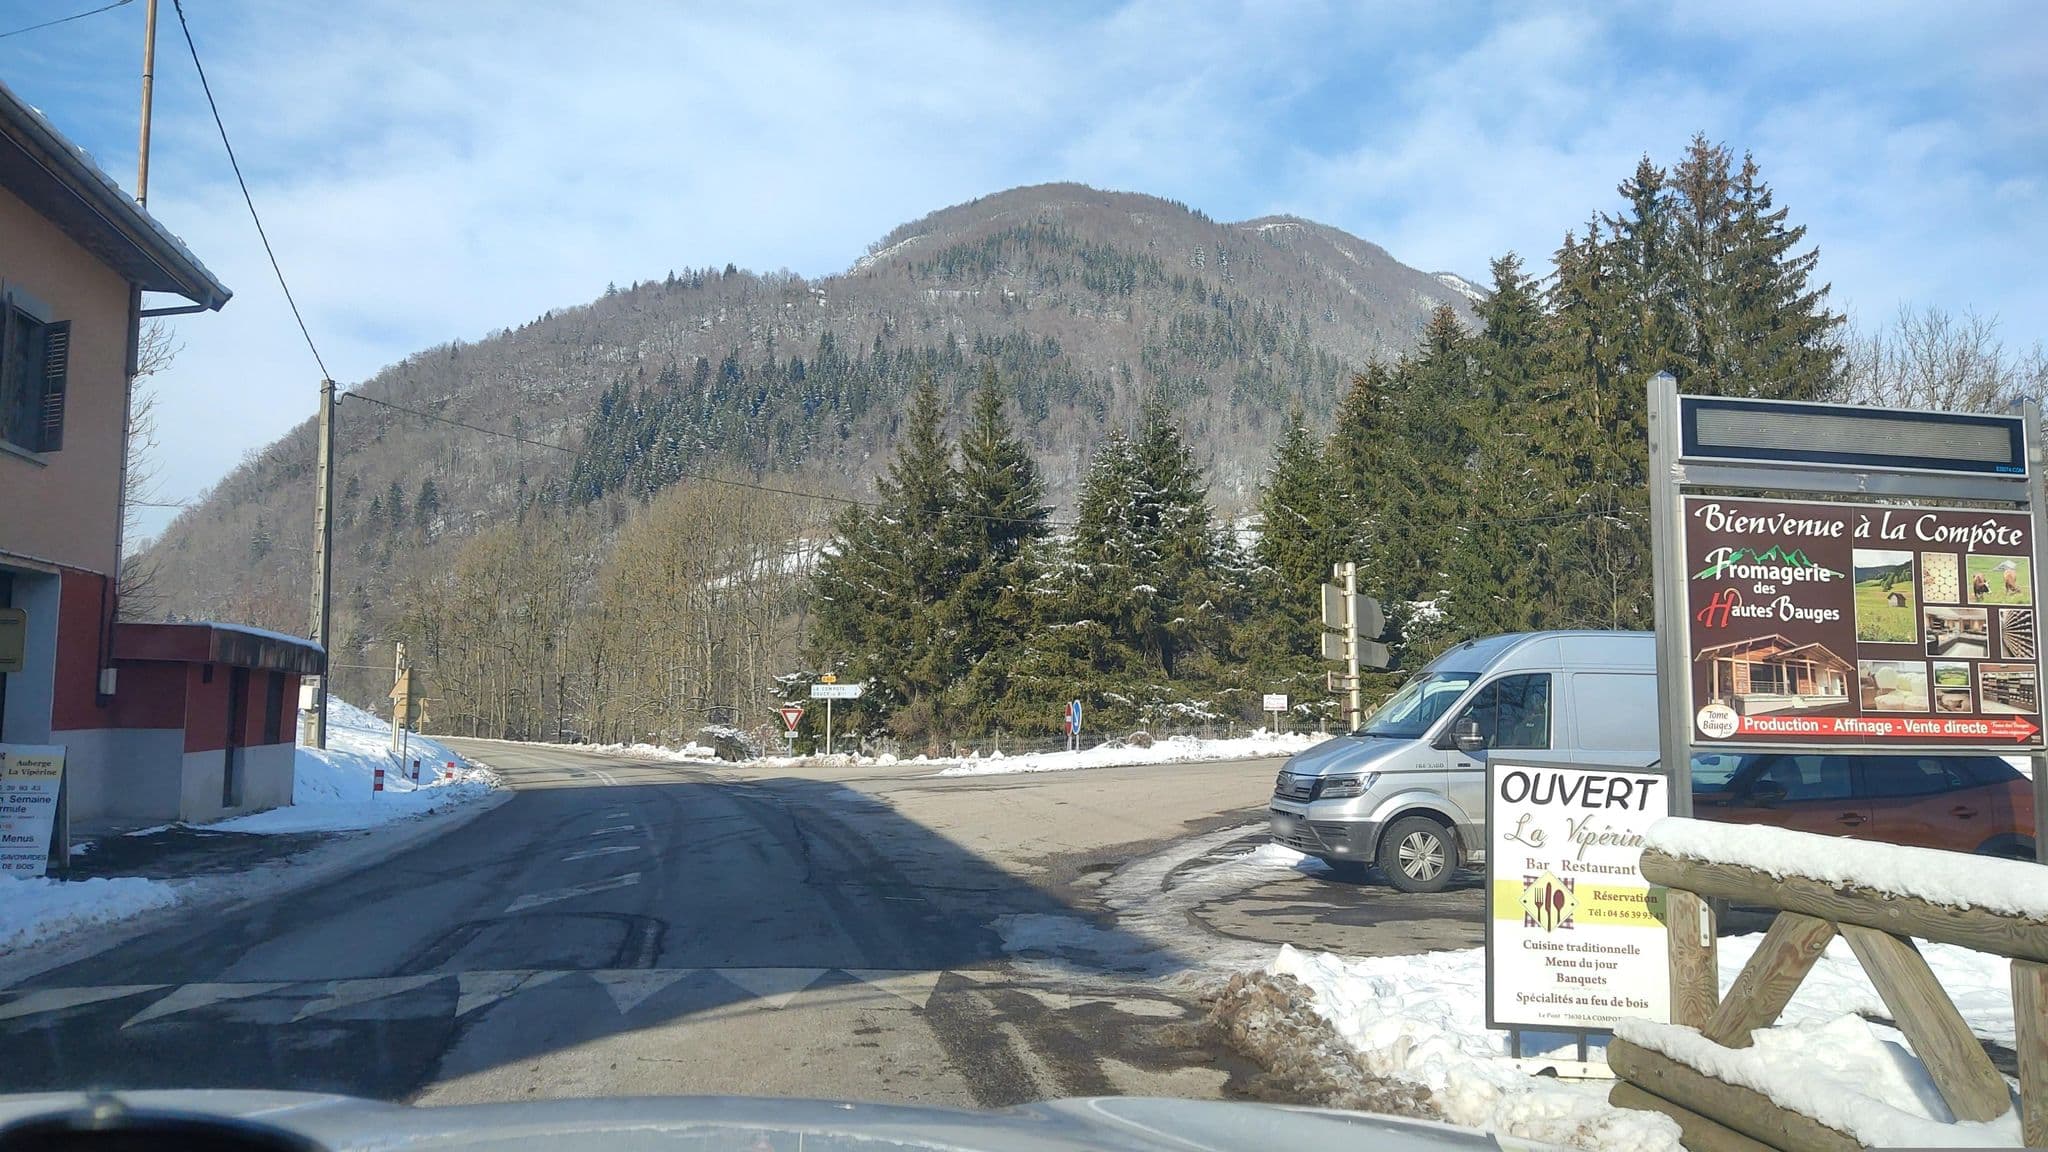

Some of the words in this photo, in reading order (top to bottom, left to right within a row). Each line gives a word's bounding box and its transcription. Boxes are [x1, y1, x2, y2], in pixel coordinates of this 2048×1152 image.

[1694, 503, 1845, 538] Bienvenue
[1854, 515, 1872, 538] à
[1880, 511, 1907, 540] la
[1915, 514, 2024, 552] Compôte
[1704, 547, 1831, 585] Fromagerie
[1753, 581, 1776, 594] des
[1697, 588, 1773, 628] Hautes
[1771, 595, 1840, 624] Bauges
[1706, 711, 1729, 719] Tome
[1703, 720, 1732, 736] Bauges
[1744, 717, 1819, 732] Production
[1834, 718, 1892, 735] Affinage
[1944, 721, 1988, 734] directe
[17, 760, 52, 768] Auberge
[10, 795, 52, 803] Semaine
[1500, 771, 1659, 811] OUVERT
[1504, 812, 1548, 848] La
[1566, 814, 1646, 861] Vipérin
[1526, 857, 1550, 870] Bar
[1561, 859, 1636, 875] Restaurant
[1593, 890, 1658, 903] Réservation
[1607, 909, 1617, 917] 04
[1619, 910, 1629, 918] 56
[1523, 939, 1564, 951] Cuisine
[1566, 942, 1641, 955] traditionnelle
[1545, 956, 1577, 968] Menu
[1580, 957, 1593, 968] du
[1595, 959, 1618, 971] jour
[1556, 972, 1607, 986] Banquets
[1516, 991, 1574, 1005] Spécialités
[1575, 997, 1589, 1005] au
[1591, 995, 1608, 1006] feu
[1610, 996, 1624, 1007] de
[1626, 997, 1649, 1009] bois
